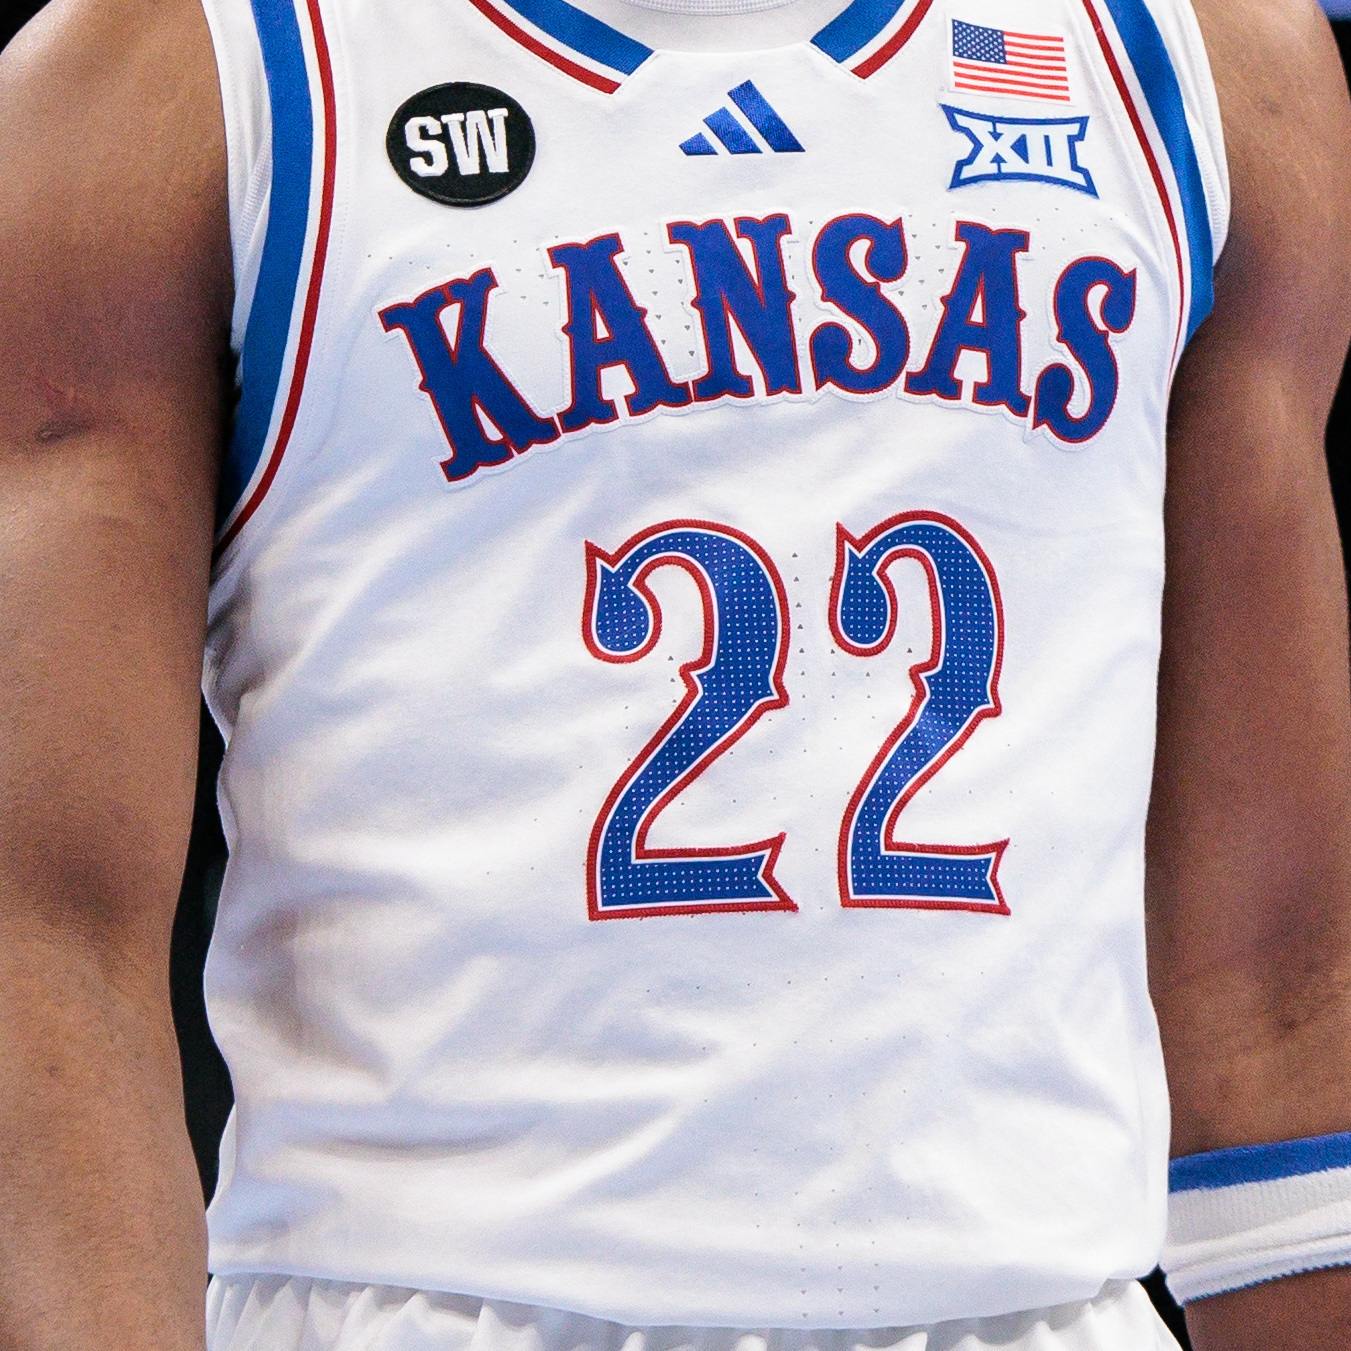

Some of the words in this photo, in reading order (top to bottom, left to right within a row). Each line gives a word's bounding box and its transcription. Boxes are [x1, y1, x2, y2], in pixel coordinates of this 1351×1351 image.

[404, 108, 509, 177] SW
[945, 106, 1094, 194] XII
[379, 213, 1137, 482] KANSAS
[581, 510, 1011, 921] 22
